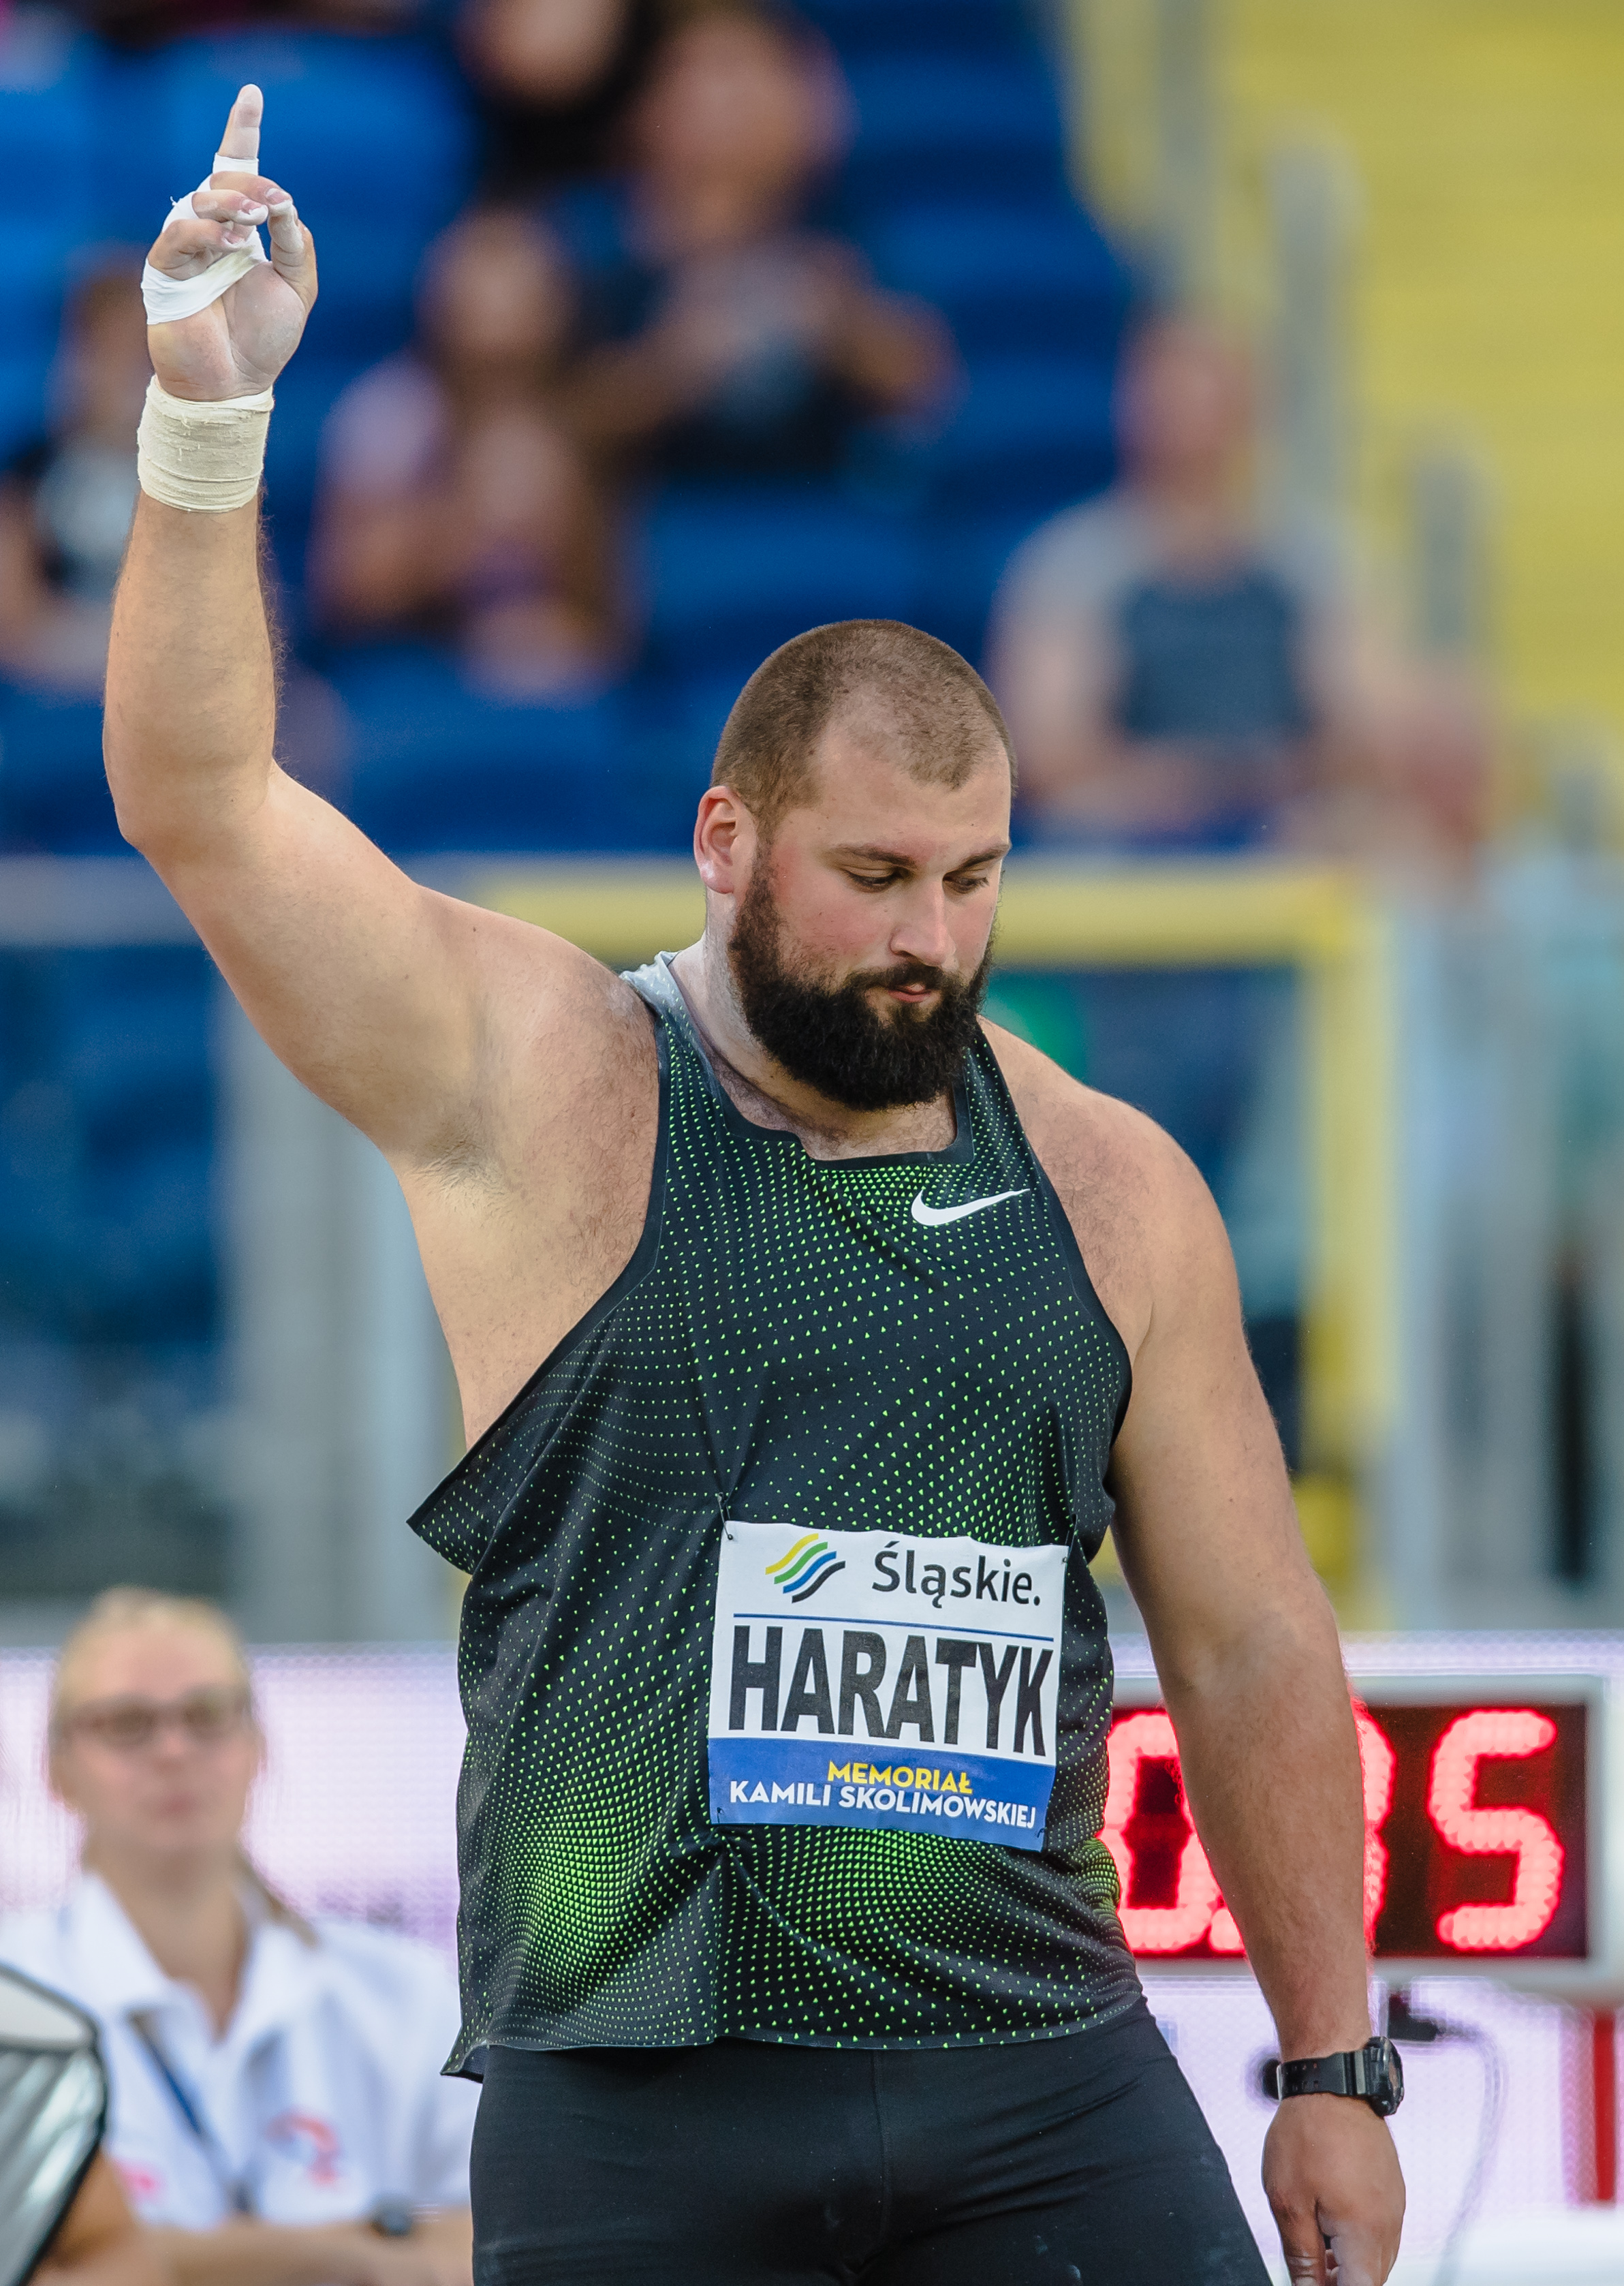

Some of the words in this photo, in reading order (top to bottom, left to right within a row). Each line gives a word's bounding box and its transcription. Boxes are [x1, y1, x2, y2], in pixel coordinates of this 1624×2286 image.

[872, 1541, 1041, 1609] Śląskie.
[728, 1624, 1054, 1757] HARATYK
[730, 1780, 830, 1806] KAMILI
[839, 1785, 1036, 1829] SKOLIMOWSKIEJ
[827, 1761, 973, 1794] MEMORIAŁ
